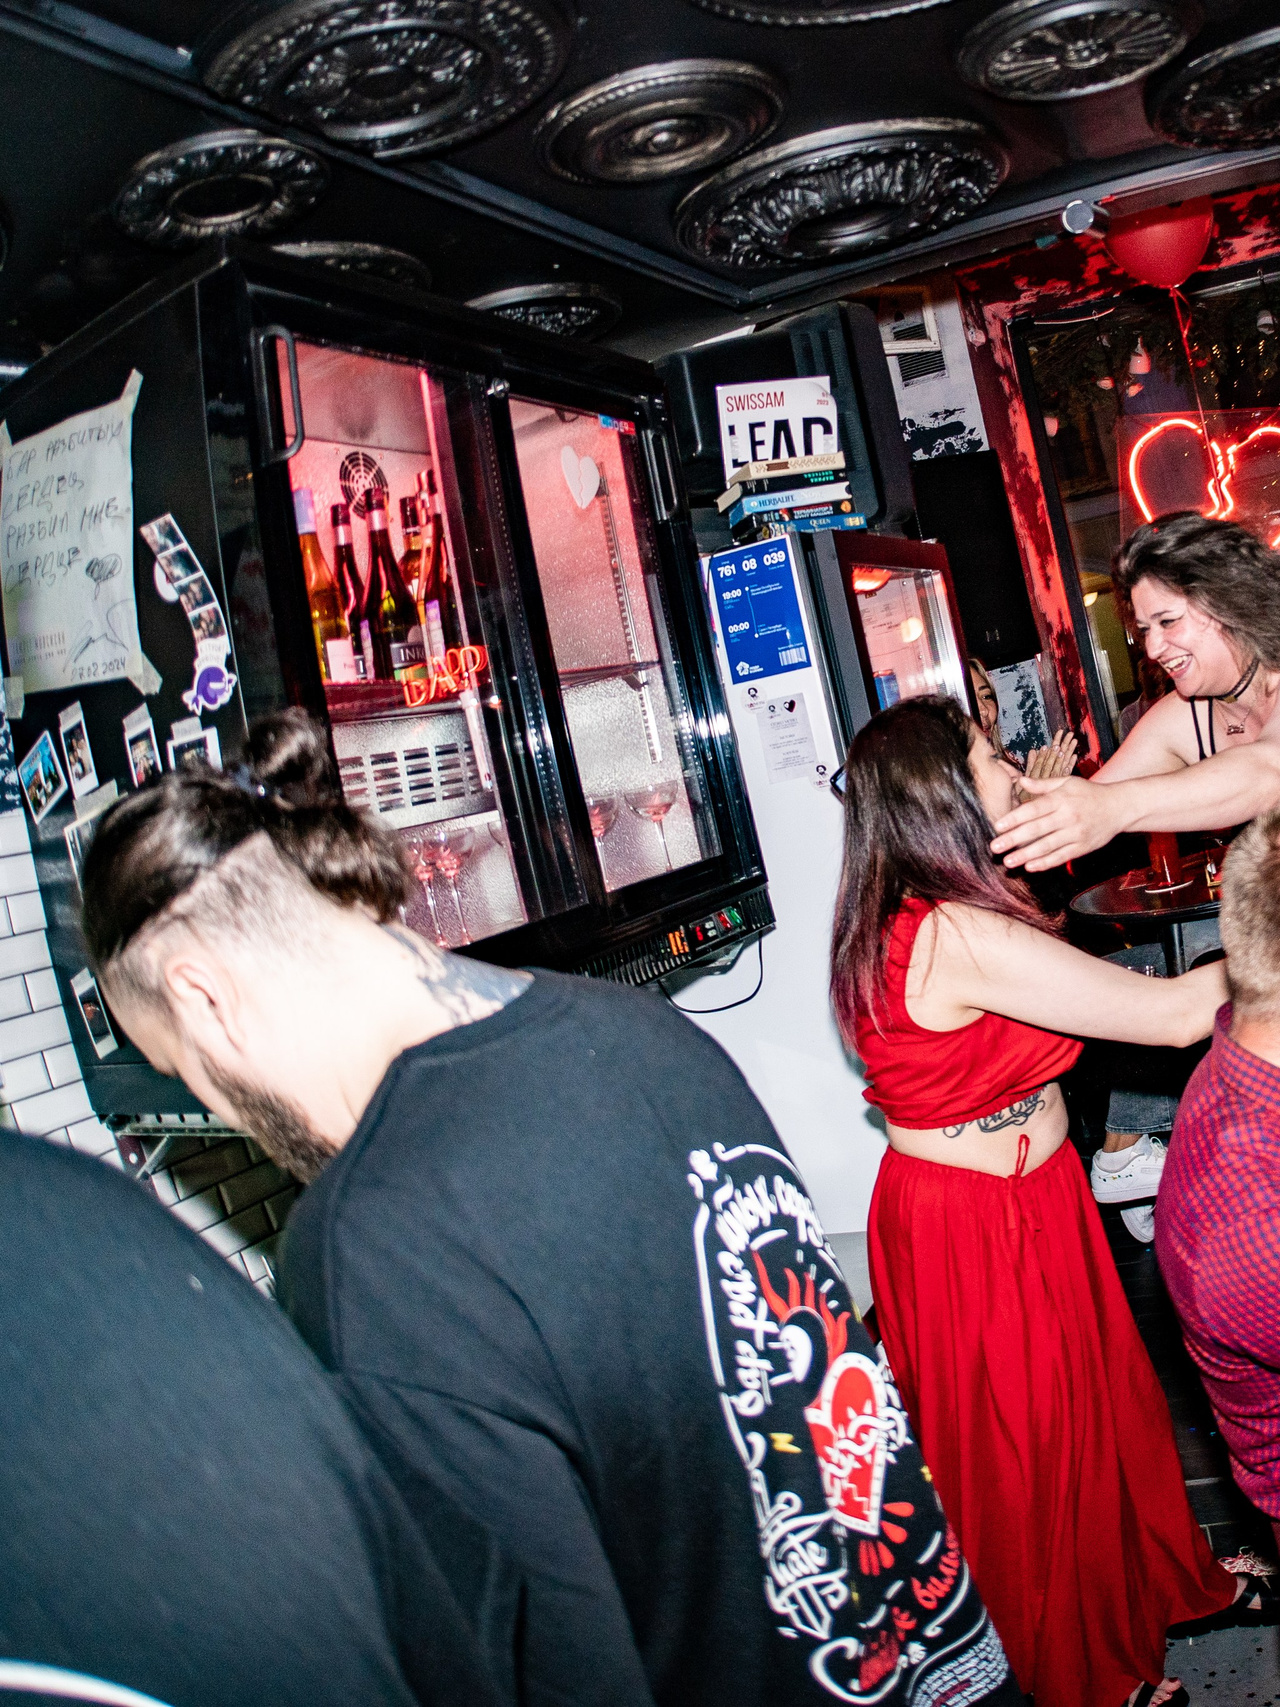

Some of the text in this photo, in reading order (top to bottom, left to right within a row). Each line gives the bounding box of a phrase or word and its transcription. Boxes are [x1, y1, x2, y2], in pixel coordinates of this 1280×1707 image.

[726, 391, 785, 412] SWISSAM
[717, 550, 786, 578] 761 08 039
[722, 588, 742, 600] 19:00
[728, 621, 749, 633] 00:00
